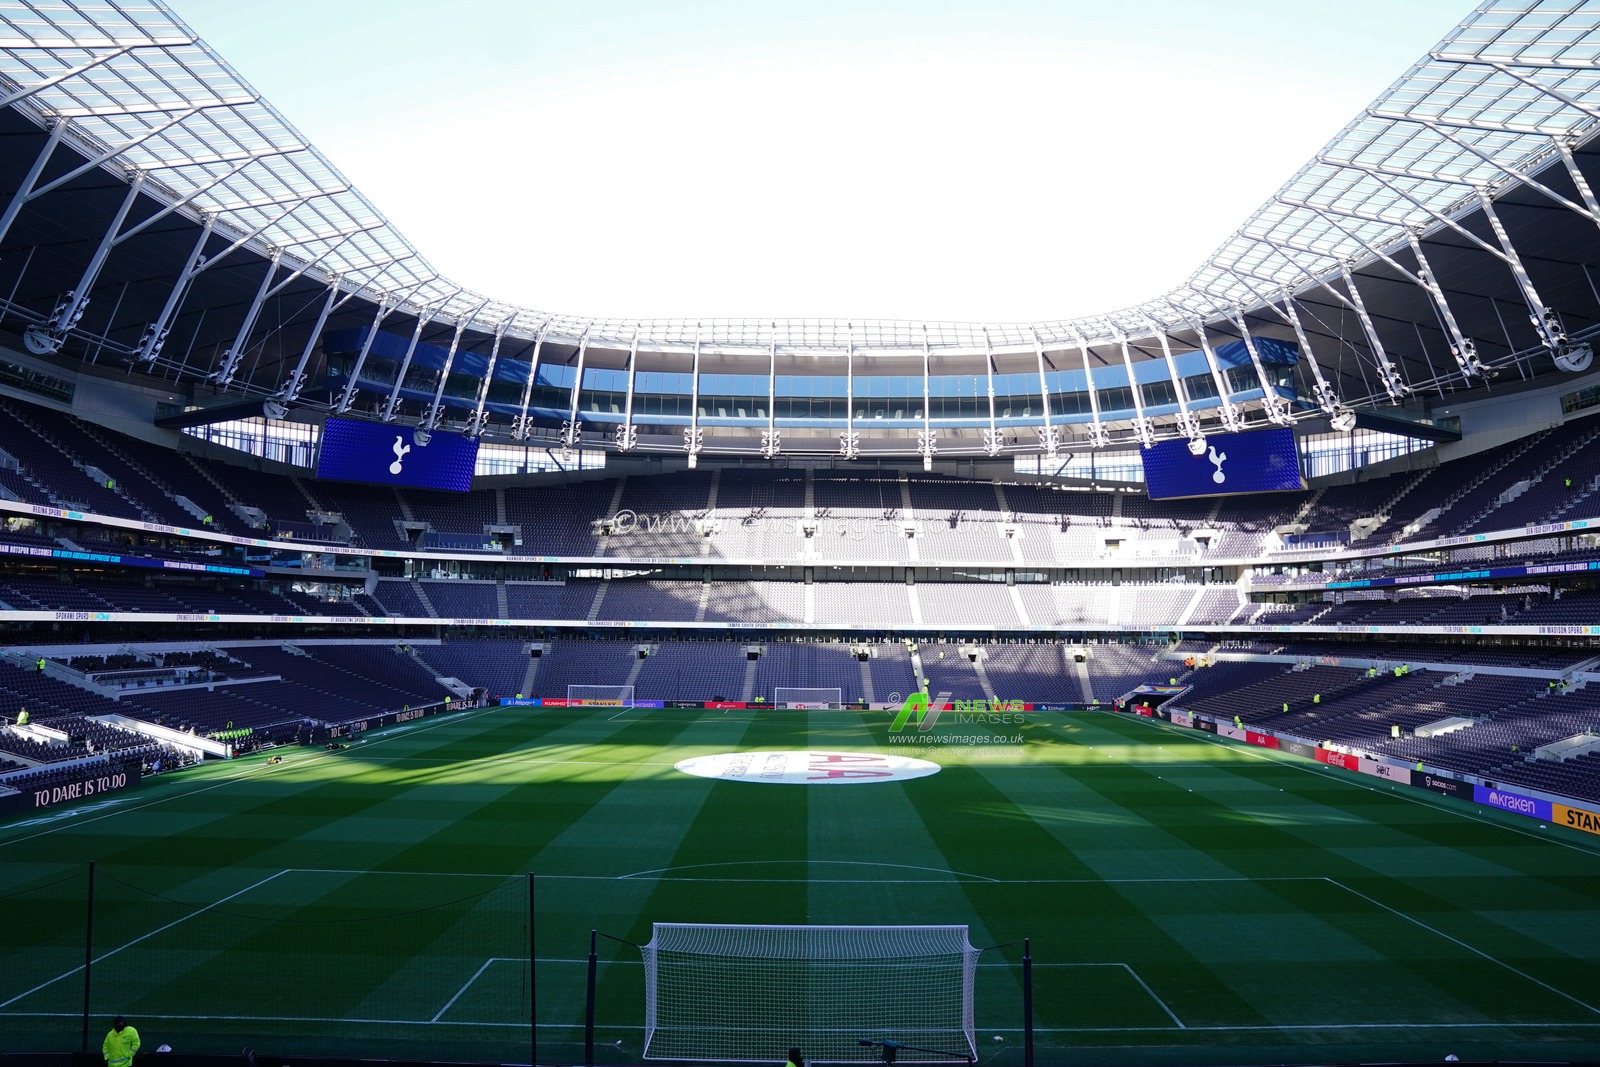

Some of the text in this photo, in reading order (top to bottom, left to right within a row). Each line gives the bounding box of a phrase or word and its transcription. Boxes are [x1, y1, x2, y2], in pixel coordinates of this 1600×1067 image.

[48, 508, 62, 516] SPURS
[1552, 522, 1564, 530] SPURS
[330, 728, 338, 738] TO
[1257, 735, 1266, 744] AIA
[34, 773, 126, 807] TO DARE IS TO DO
[1432, 779, 1456, 792] socios.com
[1499, 794, 1536, 814] kraken
